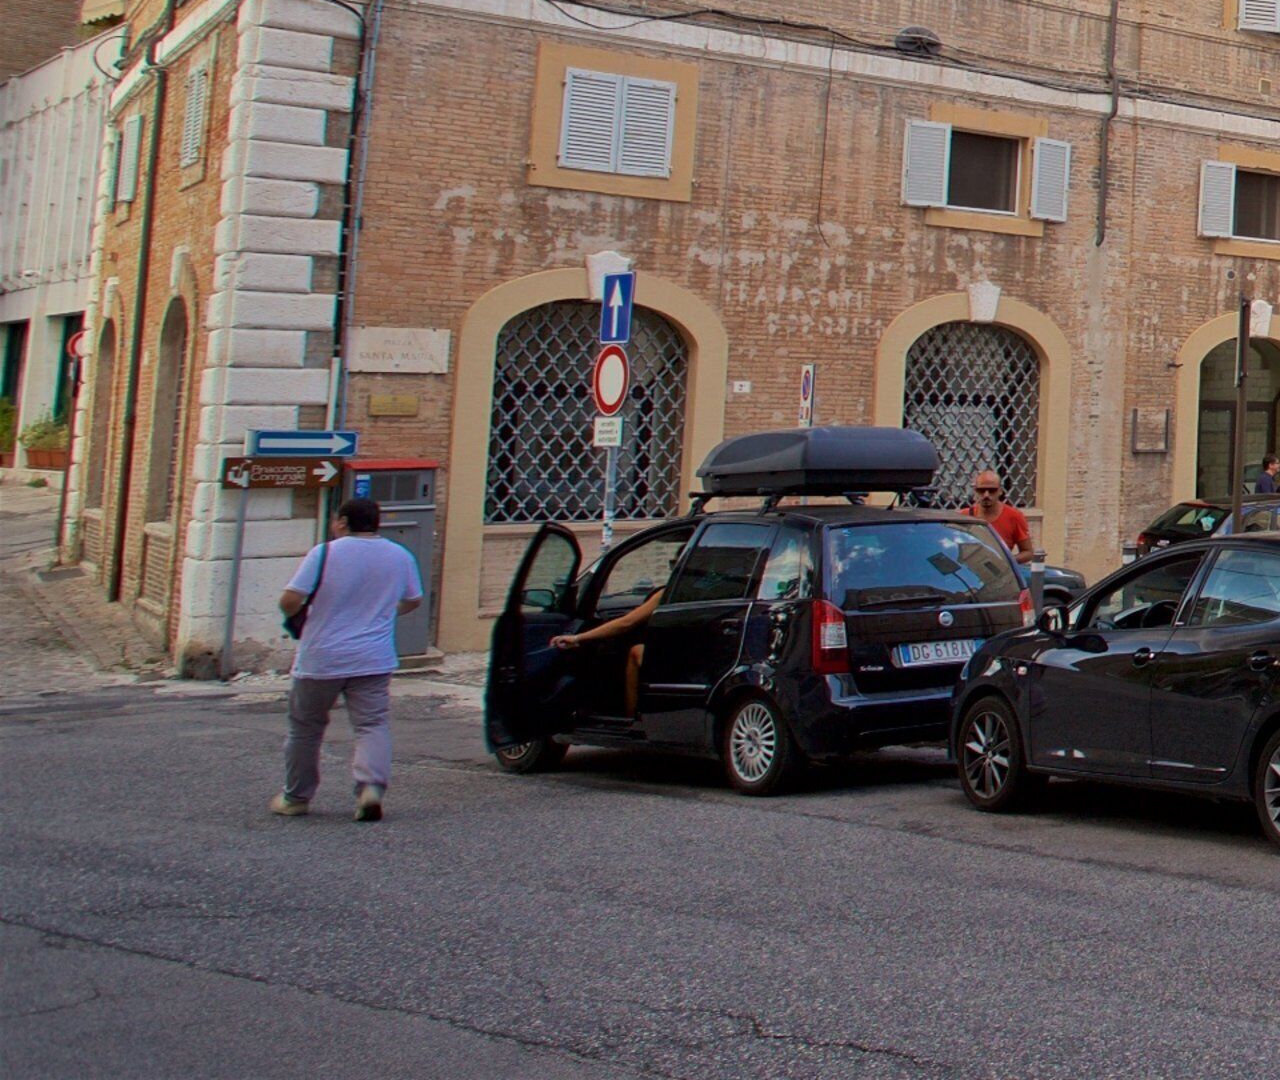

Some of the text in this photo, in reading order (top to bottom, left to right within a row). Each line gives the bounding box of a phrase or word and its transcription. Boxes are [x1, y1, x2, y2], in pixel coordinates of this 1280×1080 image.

[360, 351, 434, 361] SANTA MARIA
[251, 464, 306, 475] Pinacoteca
[250, 473, 306, 481] Comunale
[911, 644, 930, 661] DG
